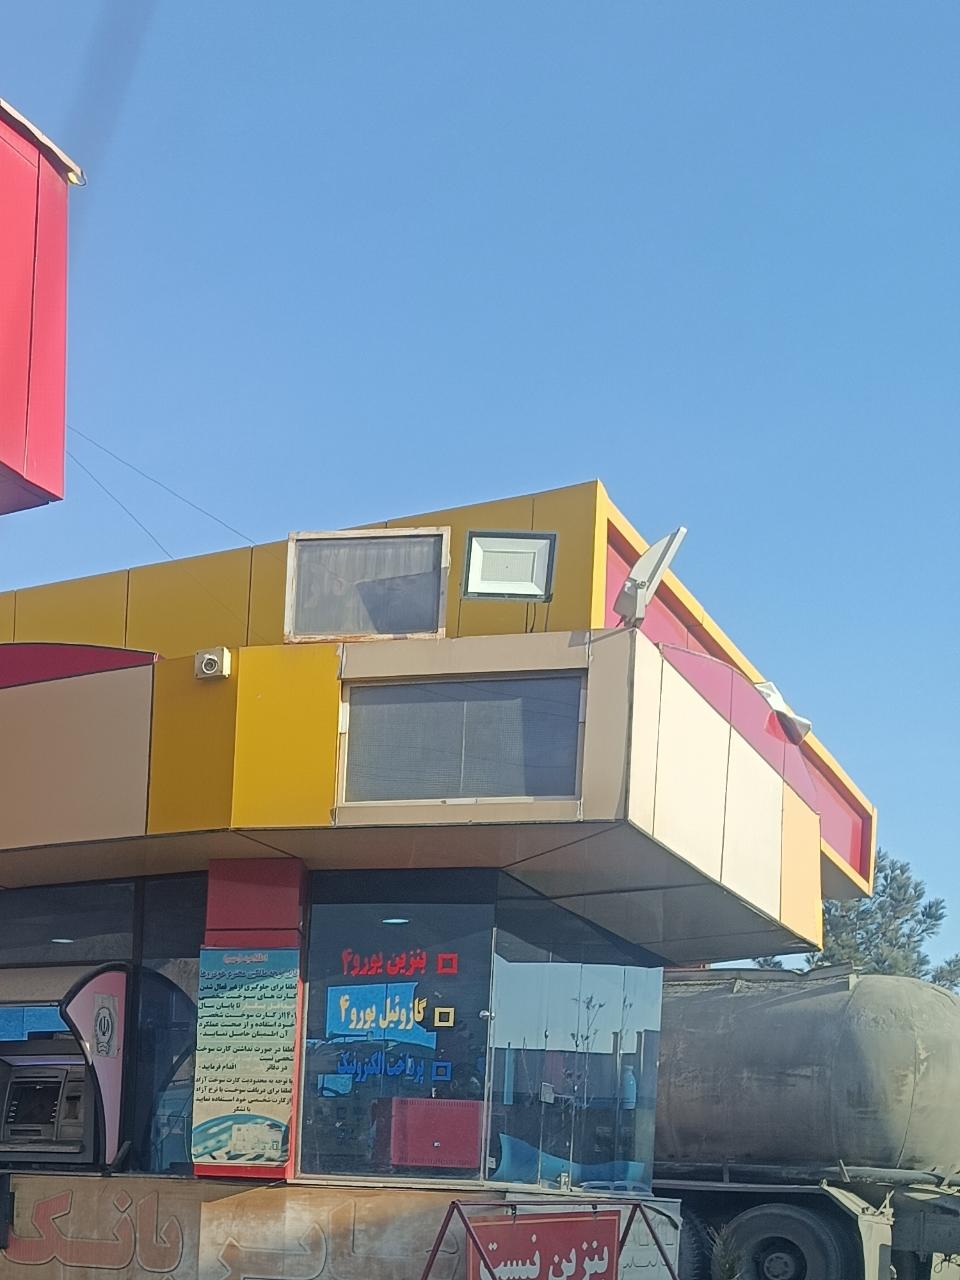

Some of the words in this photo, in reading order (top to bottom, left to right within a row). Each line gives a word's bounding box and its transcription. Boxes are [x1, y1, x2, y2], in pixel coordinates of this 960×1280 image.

[385, 948, 428, 976] بنزین
[378, 995, 428, 1030] گازوئیل
[385, 1051, 425, 1084] پرداخت
